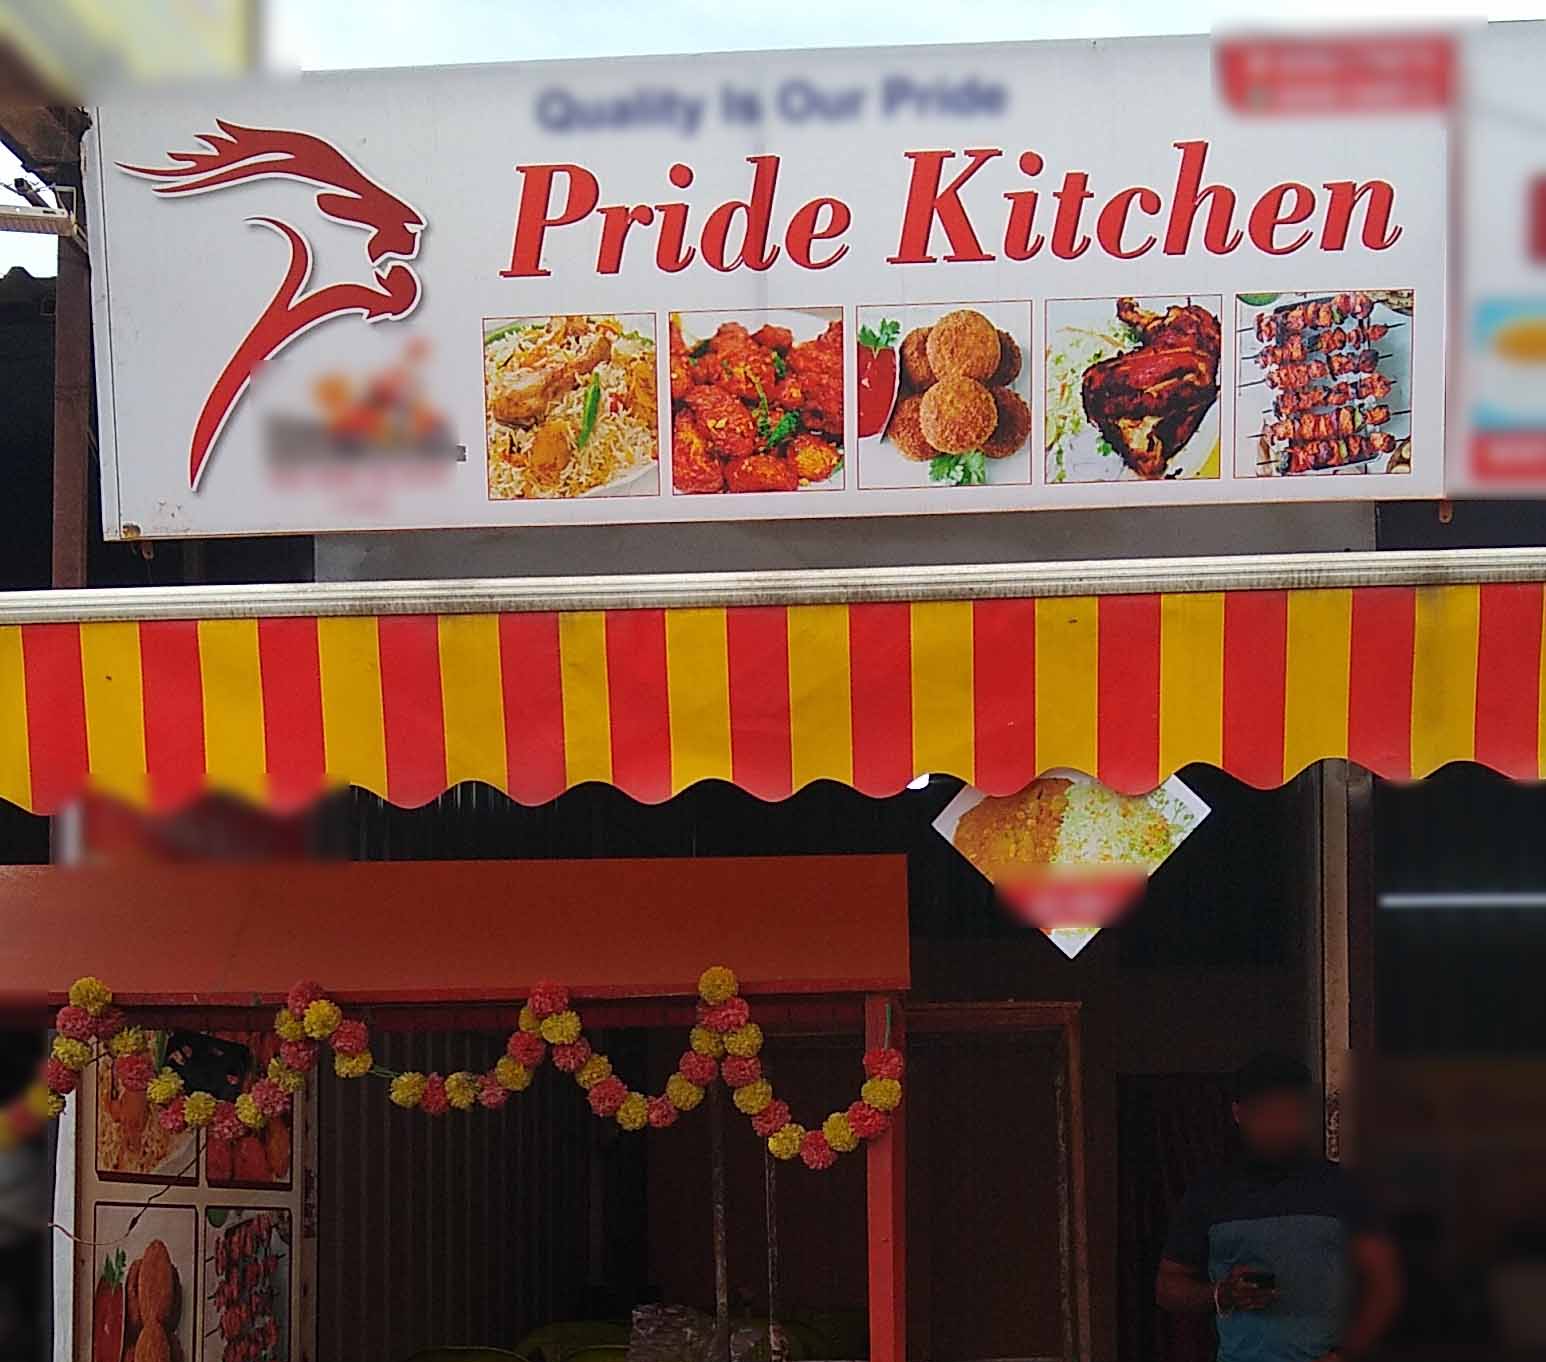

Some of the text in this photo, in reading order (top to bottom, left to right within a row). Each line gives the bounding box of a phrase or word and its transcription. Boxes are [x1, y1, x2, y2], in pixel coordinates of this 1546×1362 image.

[537, 86, 703, 134] Quality
[779, 78, 866, 124] Our
[880, 74, 1006, 117] Pride
[499, 140, 1404, 278] Pride Kitchen
